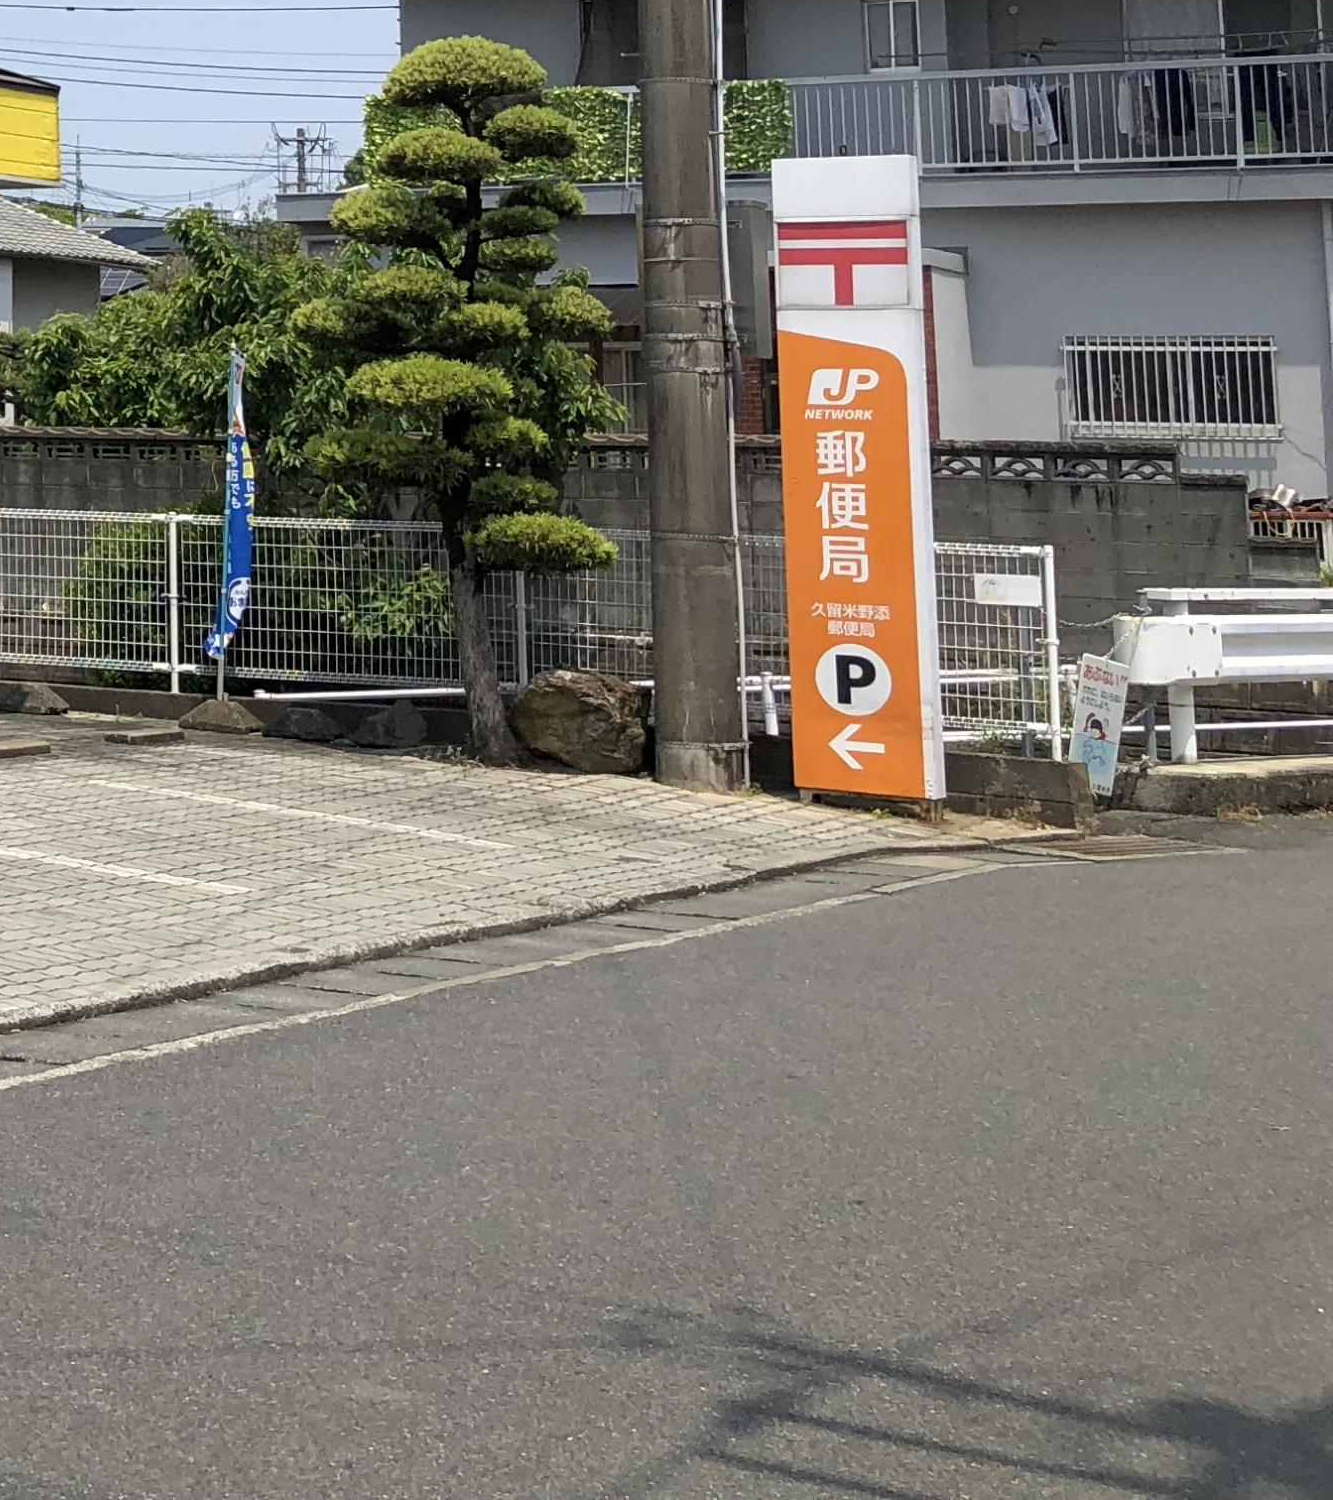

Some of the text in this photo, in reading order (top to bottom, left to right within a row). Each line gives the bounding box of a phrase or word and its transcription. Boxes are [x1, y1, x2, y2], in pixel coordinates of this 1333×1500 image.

[804, 408, 874, 421] NETWORK
[816, 429, 870, 584] 郵便局
[810, 602, 891, 622] 久留米野添
[827, 620, 876, 638] 郵便局
[835, 653, 877, 705] P
